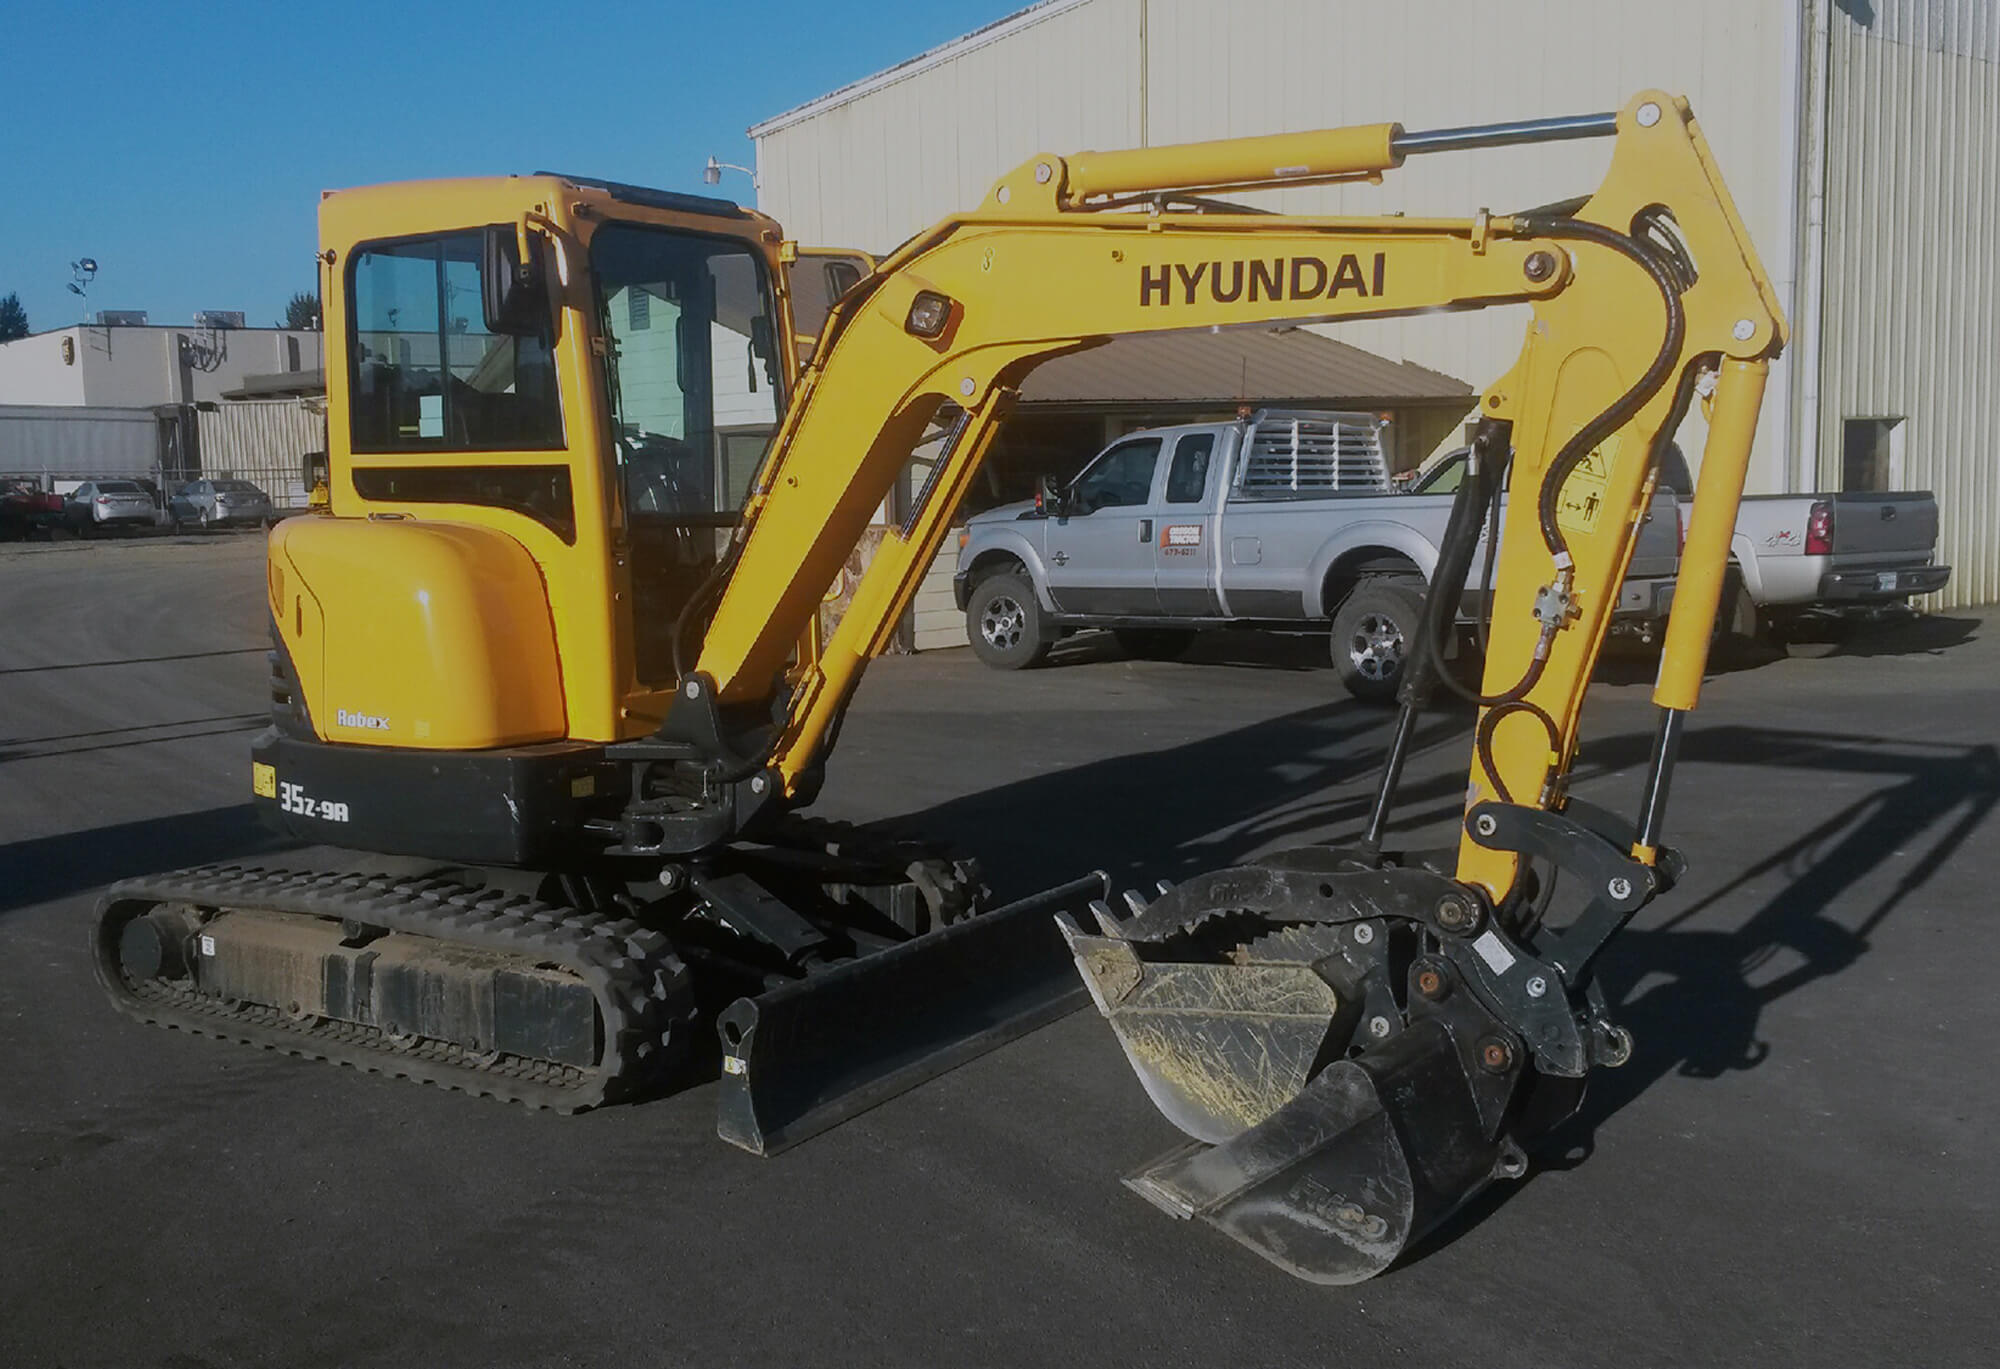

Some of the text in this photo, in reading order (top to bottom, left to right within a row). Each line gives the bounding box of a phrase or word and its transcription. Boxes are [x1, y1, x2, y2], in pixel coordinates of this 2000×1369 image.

[1140, 252, 1386, 307] HYUNDAI
[337, 709, 391, 731] Robex
[280, 781, 349, 823] 35Z-9A
